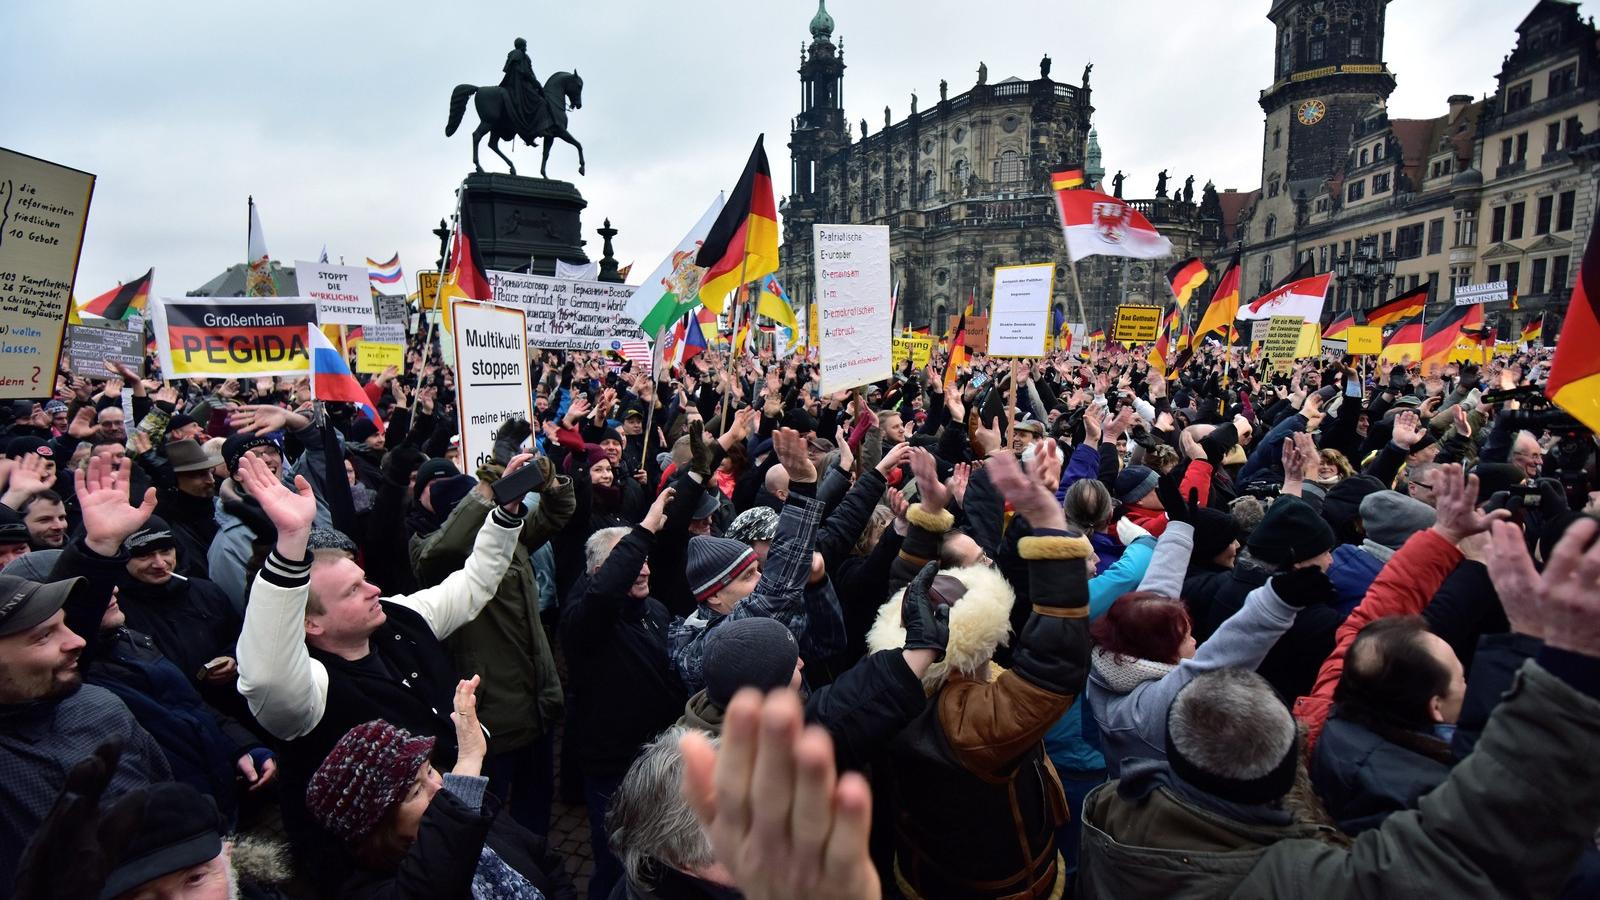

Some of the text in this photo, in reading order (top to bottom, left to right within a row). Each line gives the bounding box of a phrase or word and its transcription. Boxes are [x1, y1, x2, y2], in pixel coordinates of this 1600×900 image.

[19, 184, 36, 195] die
[18, 198, 75, 217] reformierten
[14, 212, 61, 229] friedlichen
[9, 229, 60, 246] 10 Gebote
[318, 272, 348, 281] STOPPT
[310, 291, 359, 302] WIRKLICHEN
[522, 292, 553, 306] contract
[570, 295, 600, 312] Germany
[1458, 294, 1504, 305] SACHSEN
[22, 307, 64, 321] Ungläubige
[203, 313, 285, 327] Großenhain
[12, 327, 42, 338] wollen
[465, 328, 521, 350] Multikulti
[182, 333, 310, 364] PEGIDA
[471, 359, 520, 379] stoppen
[470, 414, 498, 425] meine
